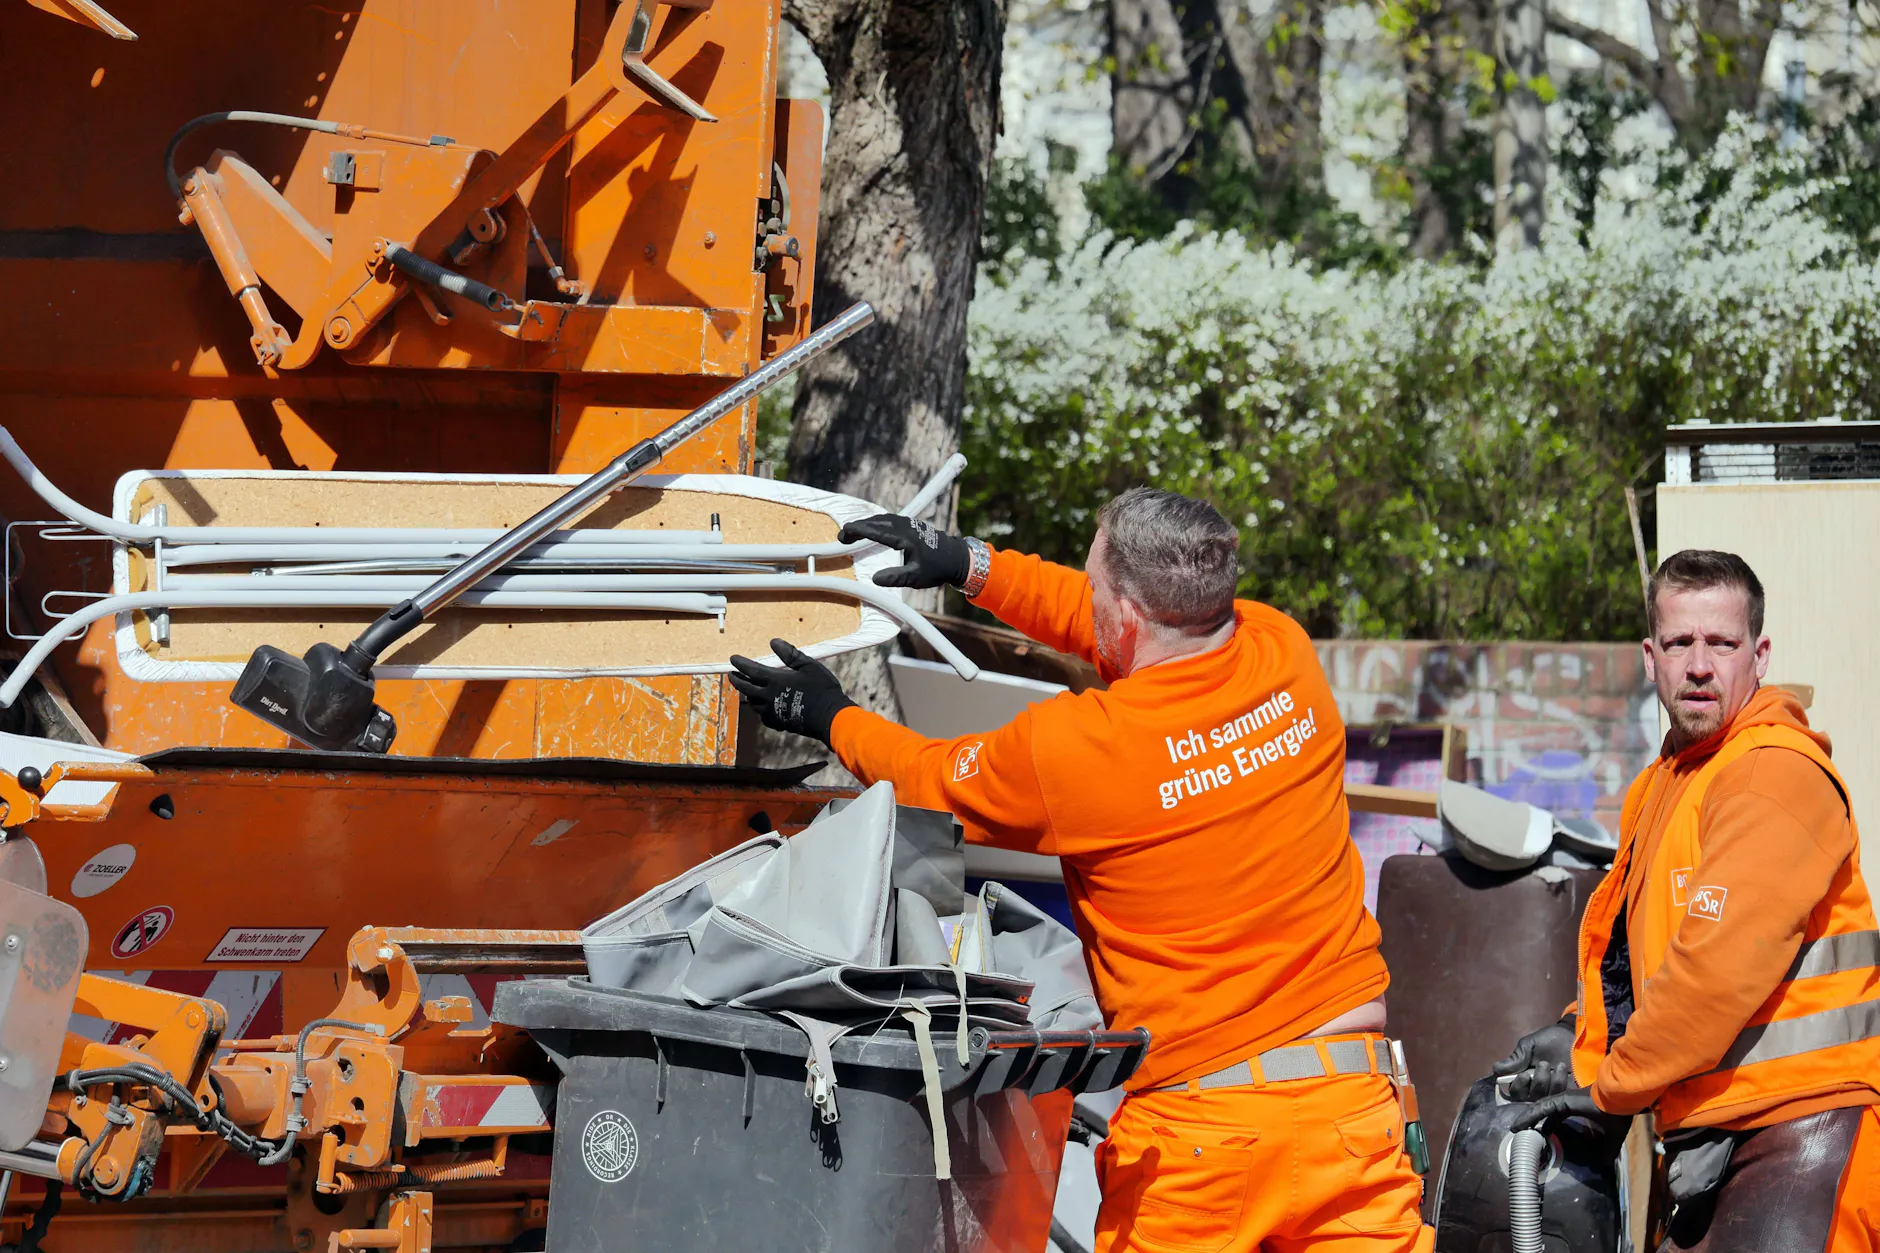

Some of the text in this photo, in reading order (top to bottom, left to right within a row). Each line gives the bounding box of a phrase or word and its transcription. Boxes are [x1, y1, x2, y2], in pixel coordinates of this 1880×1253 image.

[260, 696, 288, 715] Dirt Devil
[1165, 691, 1295, 764] Ich sammle
[1158, 707, 1317, 809] grüne Energie!
[92, 864, 127, 874] ZOELLER
[1694, 890, 1719, 914] BSR
[235, 933, 305, 943] Nicht hinter den
[217, 947, 301, 957] Schwenkarm treten
[586, 1122, 597, 1138] RIDE
[623, 1123, 632, 1135] DIE
[586, 1145, 635, 1178] KLASSE RECORDINGS
